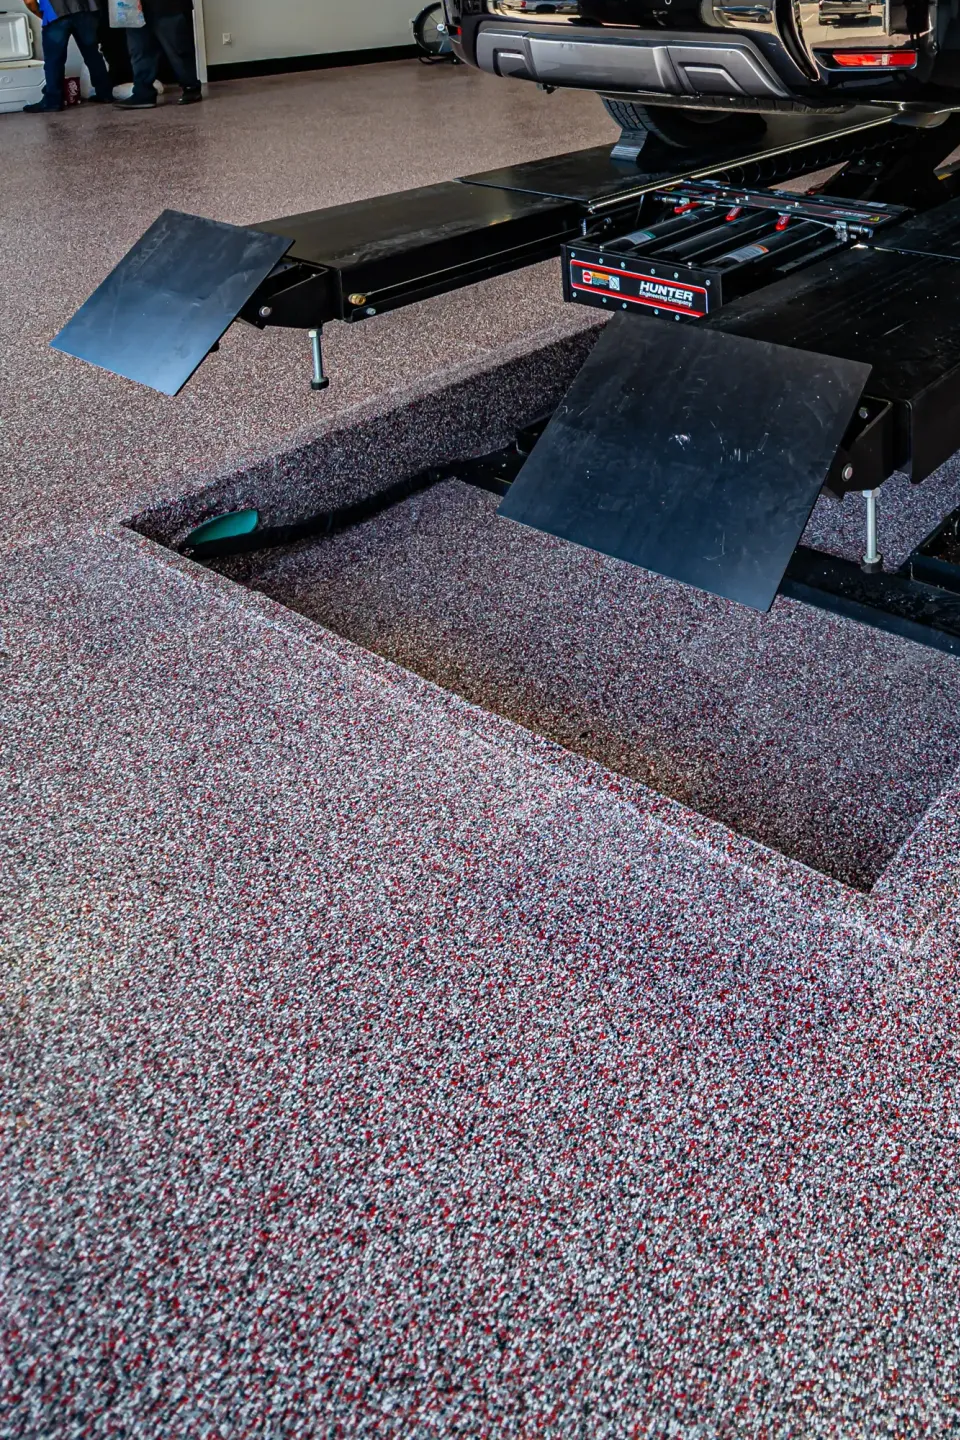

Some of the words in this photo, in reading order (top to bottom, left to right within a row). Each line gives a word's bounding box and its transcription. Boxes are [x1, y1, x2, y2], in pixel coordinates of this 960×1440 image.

[639, 281, 694, 301] HUNTER
[639, 290, 668, 302] Engineering
[667, 296, 693, 307] Company
